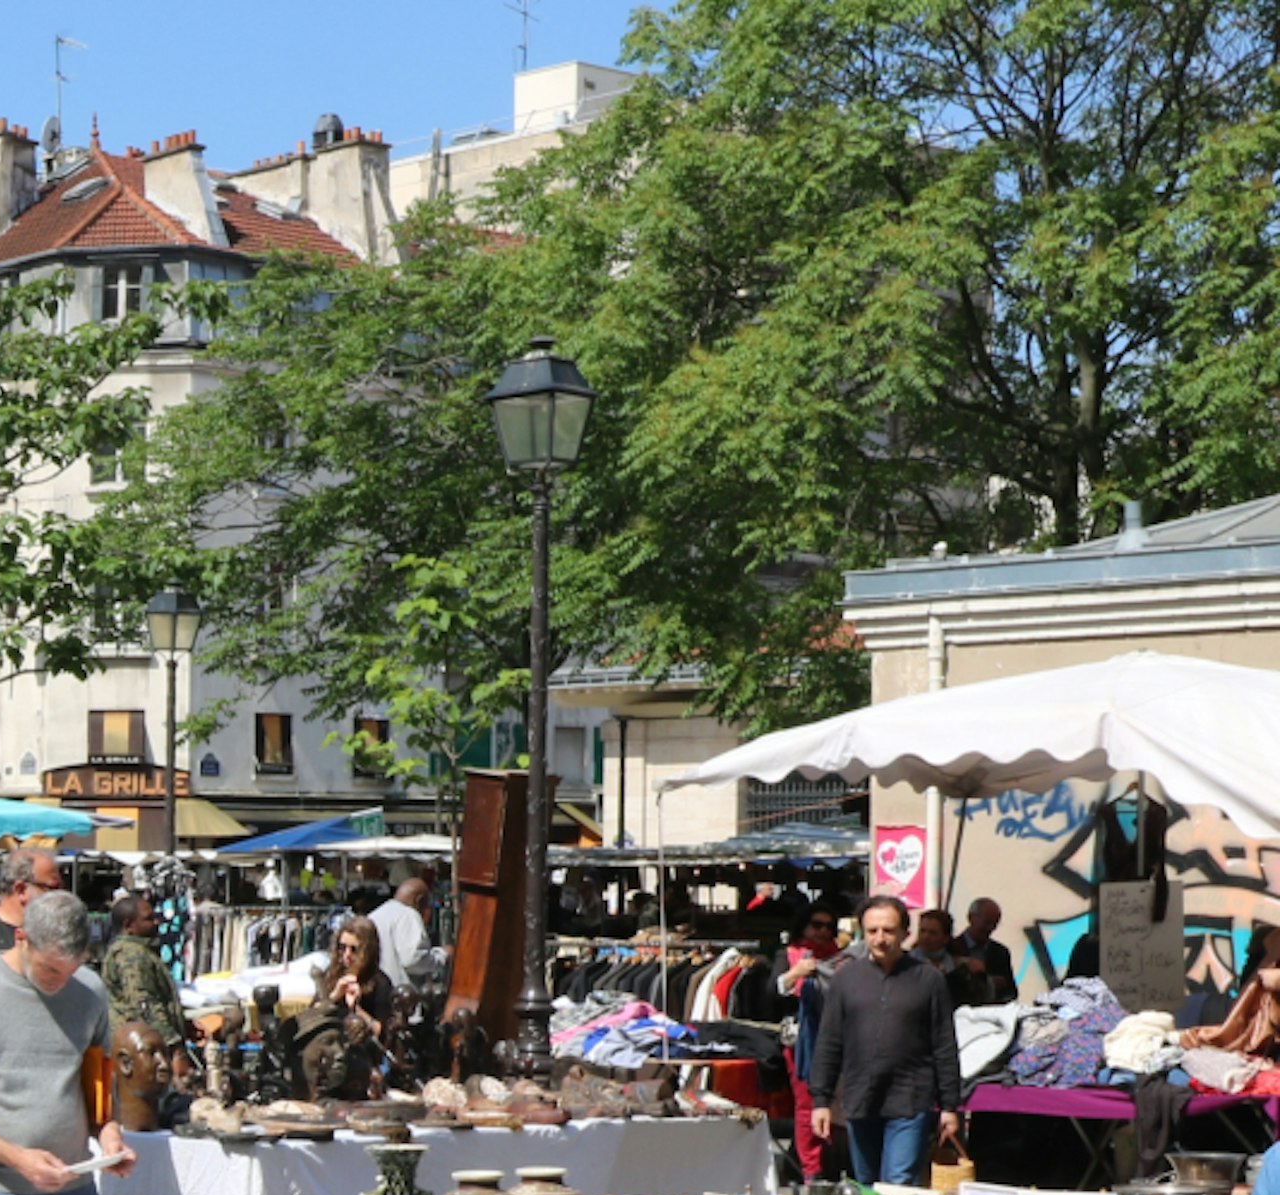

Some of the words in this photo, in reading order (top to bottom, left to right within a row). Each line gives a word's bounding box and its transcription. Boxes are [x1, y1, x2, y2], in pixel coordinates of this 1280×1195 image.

[91, 756, 103, 764] LA
[105, 756, 139, 765] GRILLE
[46, 771, 84, 795] LA
[93, 771, 189, 796] GRILLE
